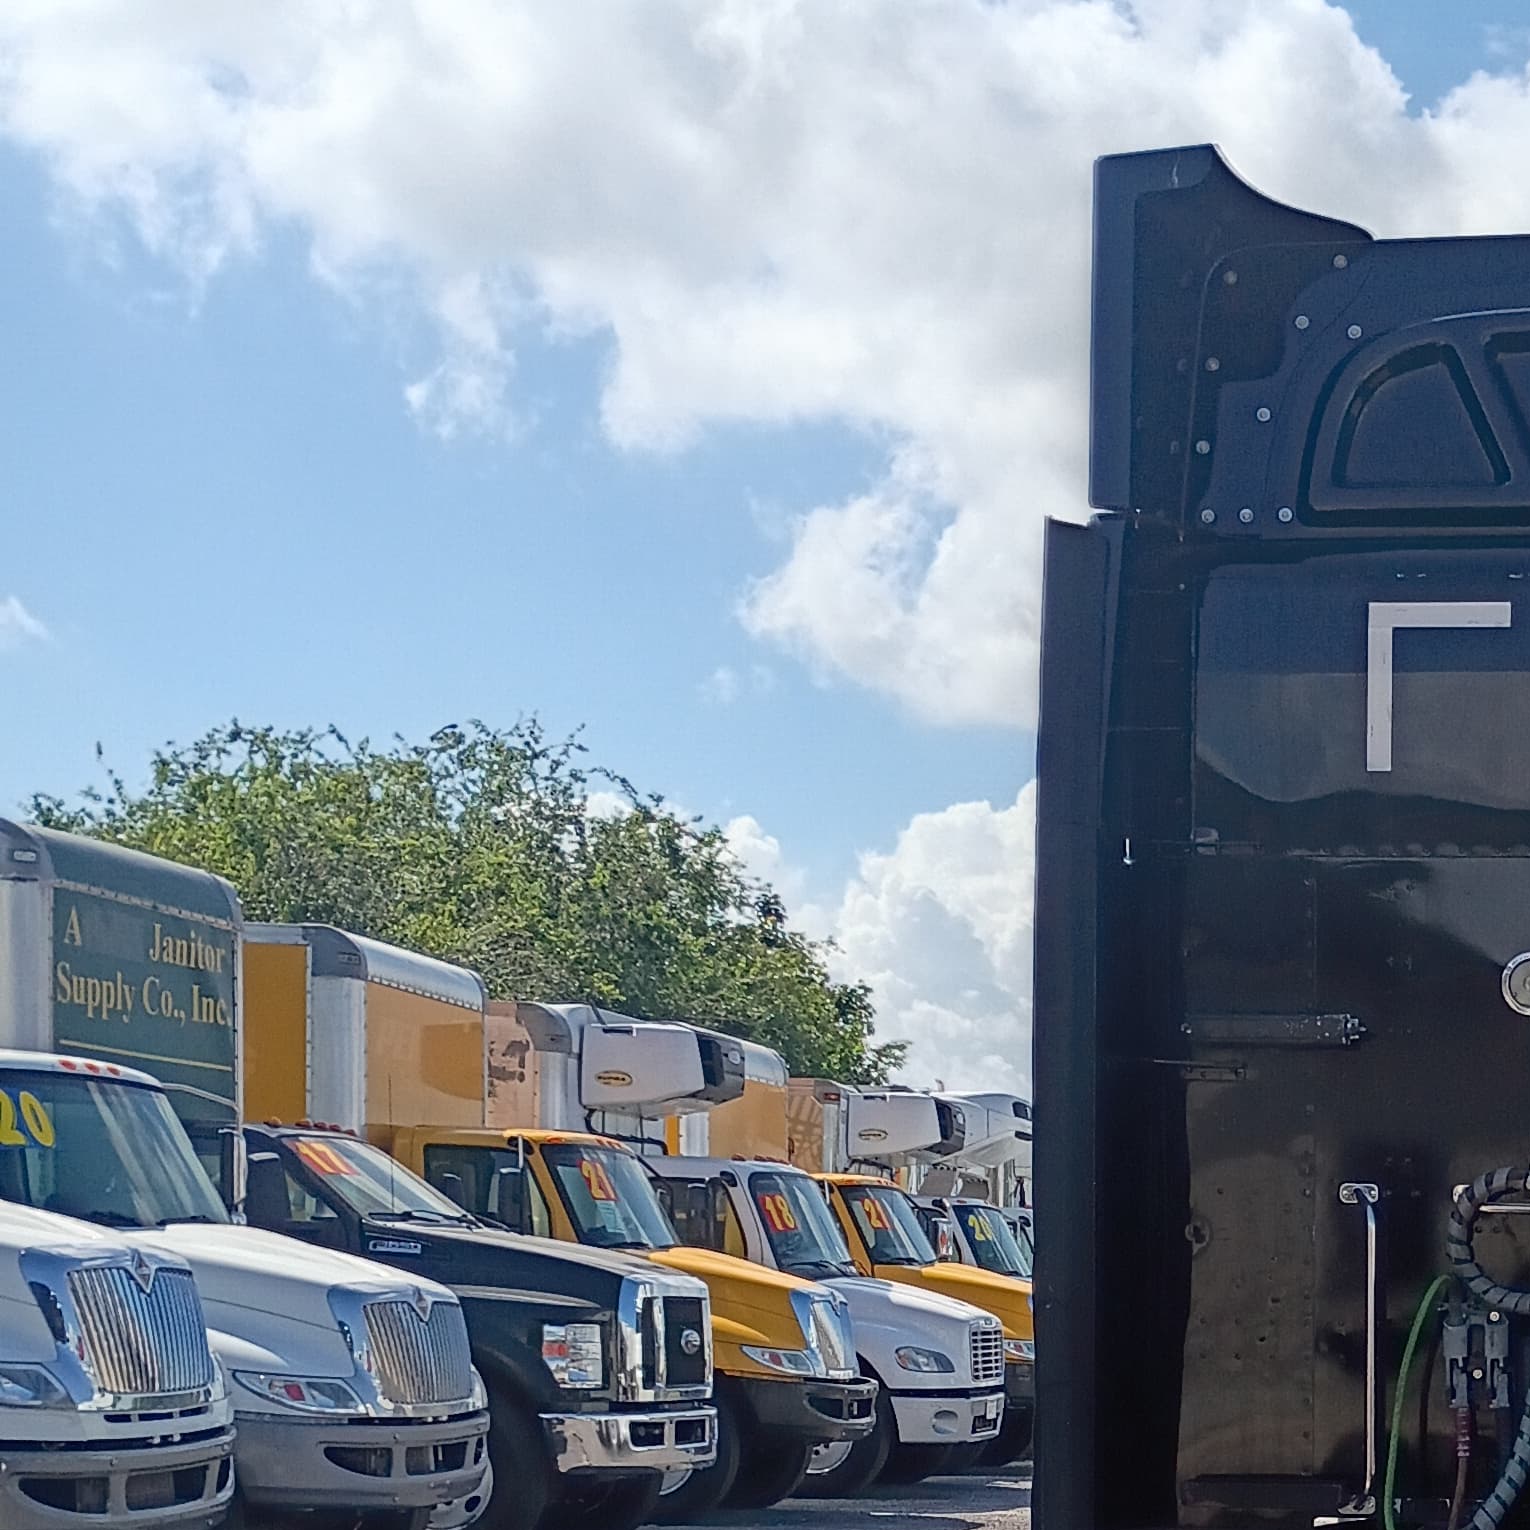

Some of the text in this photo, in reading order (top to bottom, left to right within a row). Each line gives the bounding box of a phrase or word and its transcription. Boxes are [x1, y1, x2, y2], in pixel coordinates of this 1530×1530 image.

[64, 905, 226, 973] A Janitor
[57, 960, 232, 1027] Supply Co., Inc.
[0, 1088, 56, 1147] 20
[295, 1141, 352, 1175] 17
[581, 1159, 617, 1201] 21
[765, 1195, 796, 1231] 18
[862, 1198, 890, 1229] 21
